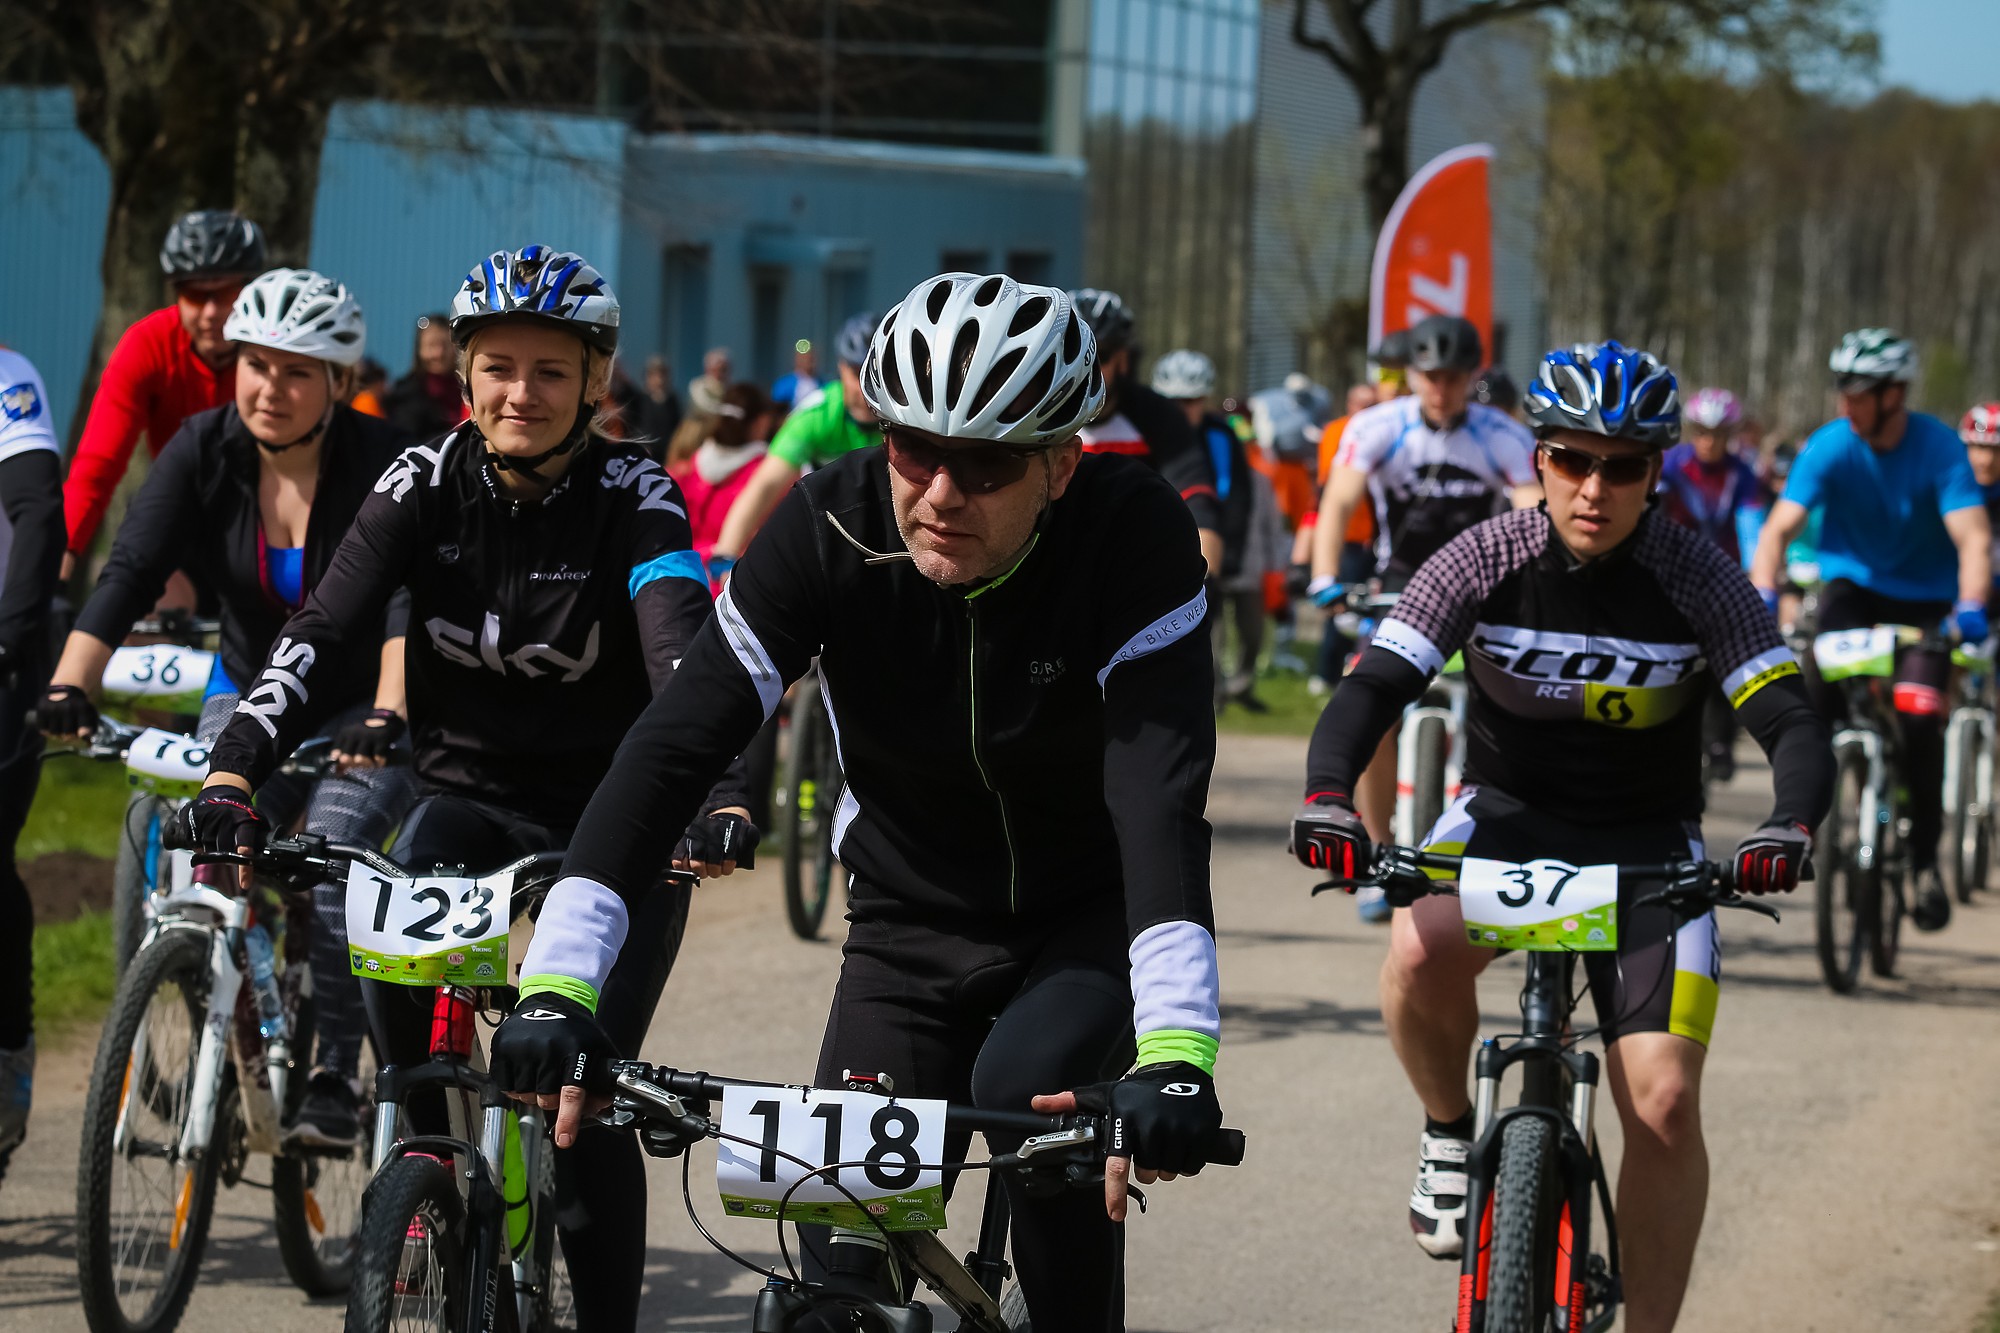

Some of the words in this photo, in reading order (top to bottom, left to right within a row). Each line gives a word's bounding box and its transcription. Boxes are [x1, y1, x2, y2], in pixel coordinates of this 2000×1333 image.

[425, 611, 600, 683] sky
[1146, 619, 1182, 646] BIKE
[132, 654, 180, 685] 36
[1535, 684, 1572, 700] RC
[1497, 866, 1579, 908] 37
[369, 876, 494, 942] 123
[574, 1052, 587, 1081] GIRO
[749, 1099, 921, 1190] 118
[1114, 1117, 1123, 1149] GIRO
[895, 1196, 923, 1204] VIKING
